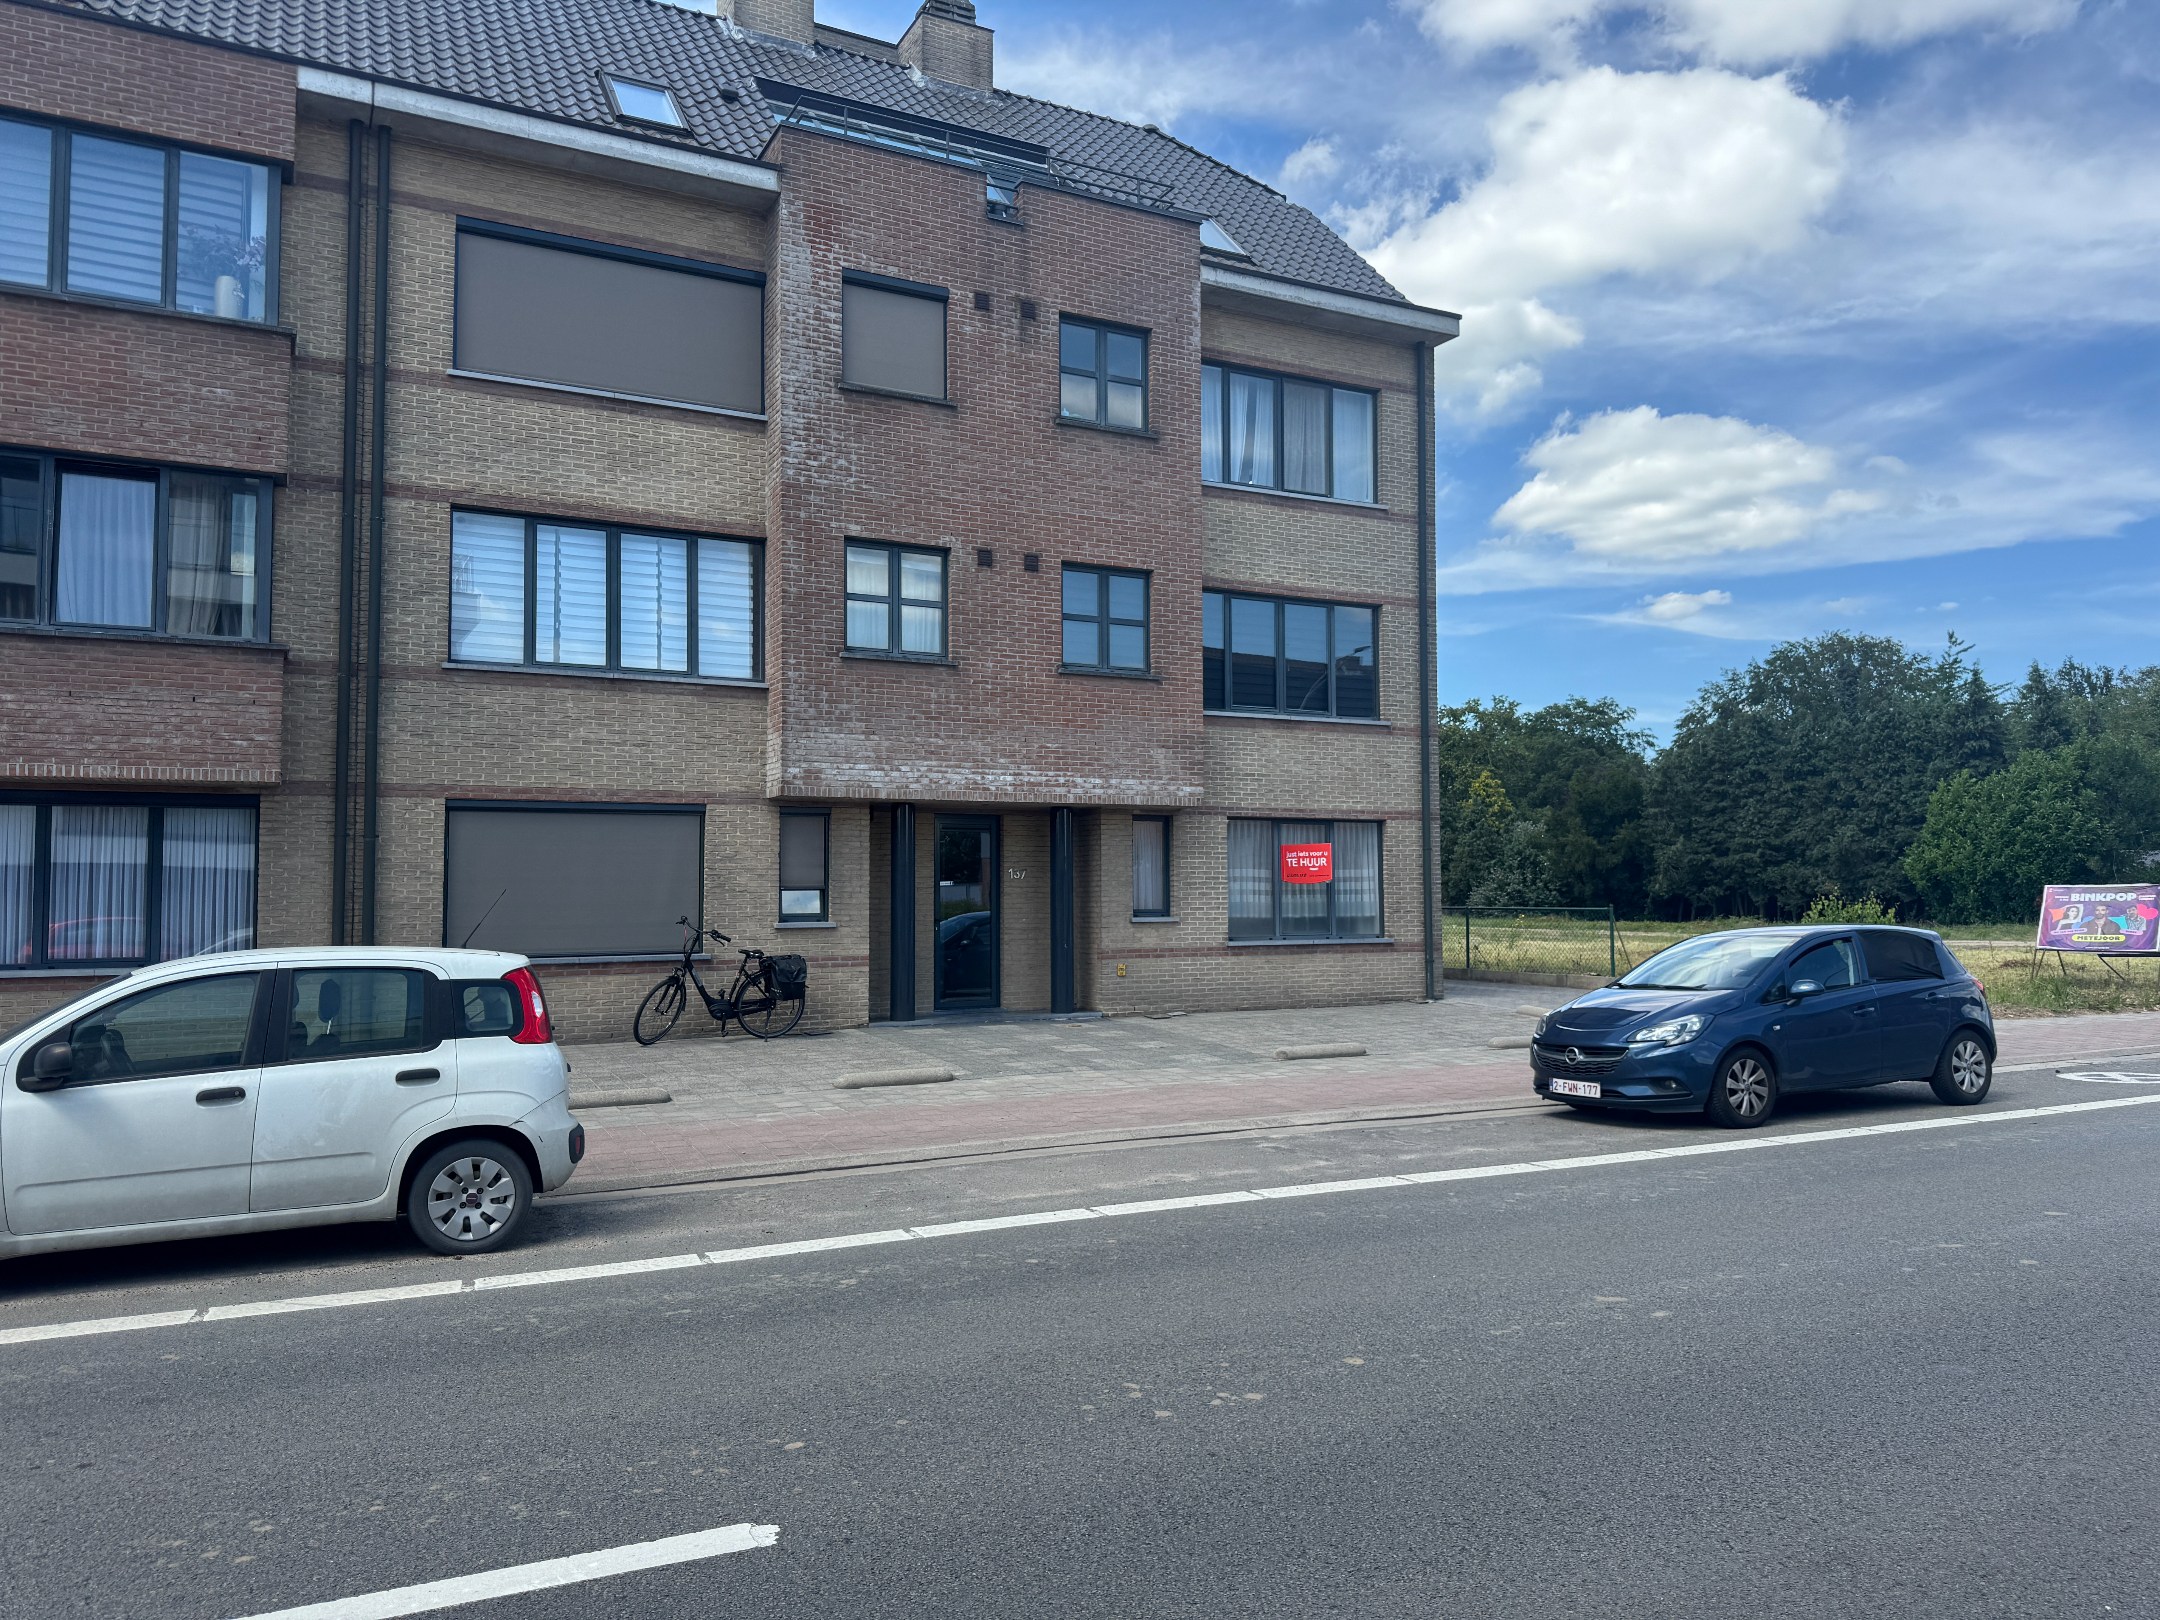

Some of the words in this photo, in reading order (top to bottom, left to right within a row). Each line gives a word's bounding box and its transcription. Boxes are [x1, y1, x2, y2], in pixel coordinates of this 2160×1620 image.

[1286, 858, 1298, 867] TE
[1300, 857, 1328, 867] HUUR
[1008, 868, 1027, 880] 137
[2070, 892, 2137, 902] BINKPOP
[1553, 1080, 1598, 1096] 2-FWN-177
